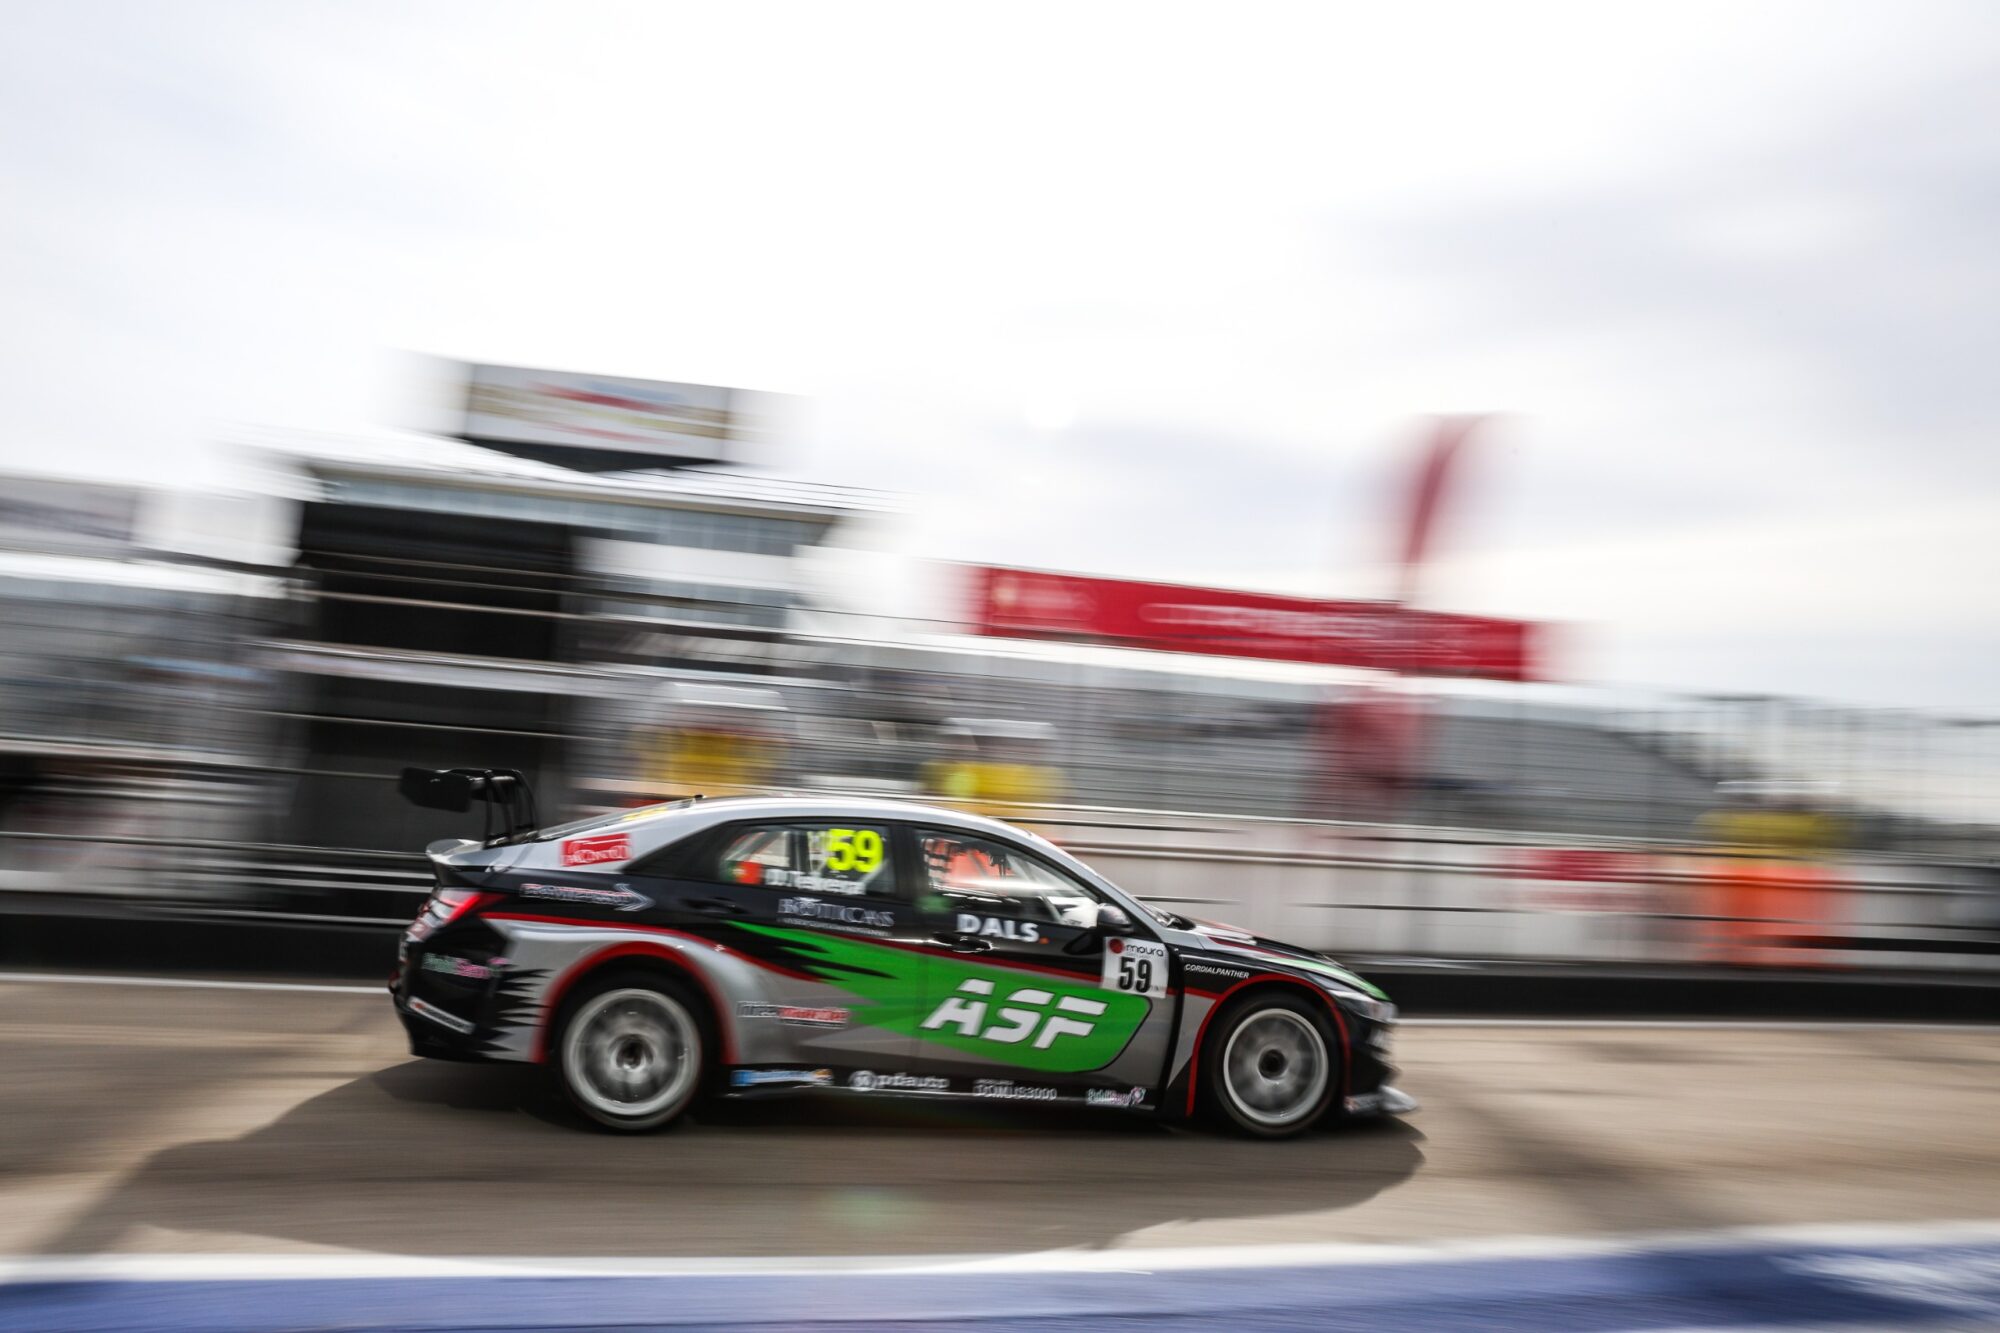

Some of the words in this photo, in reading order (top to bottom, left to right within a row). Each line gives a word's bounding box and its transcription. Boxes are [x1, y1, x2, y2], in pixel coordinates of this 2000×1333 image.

[826, 828, 884, 873] 59
[1126, 944, 1164, 957] moura
[1118, 956, 1153, 993] 59
[919, 978, 1109, 1050] ASF
